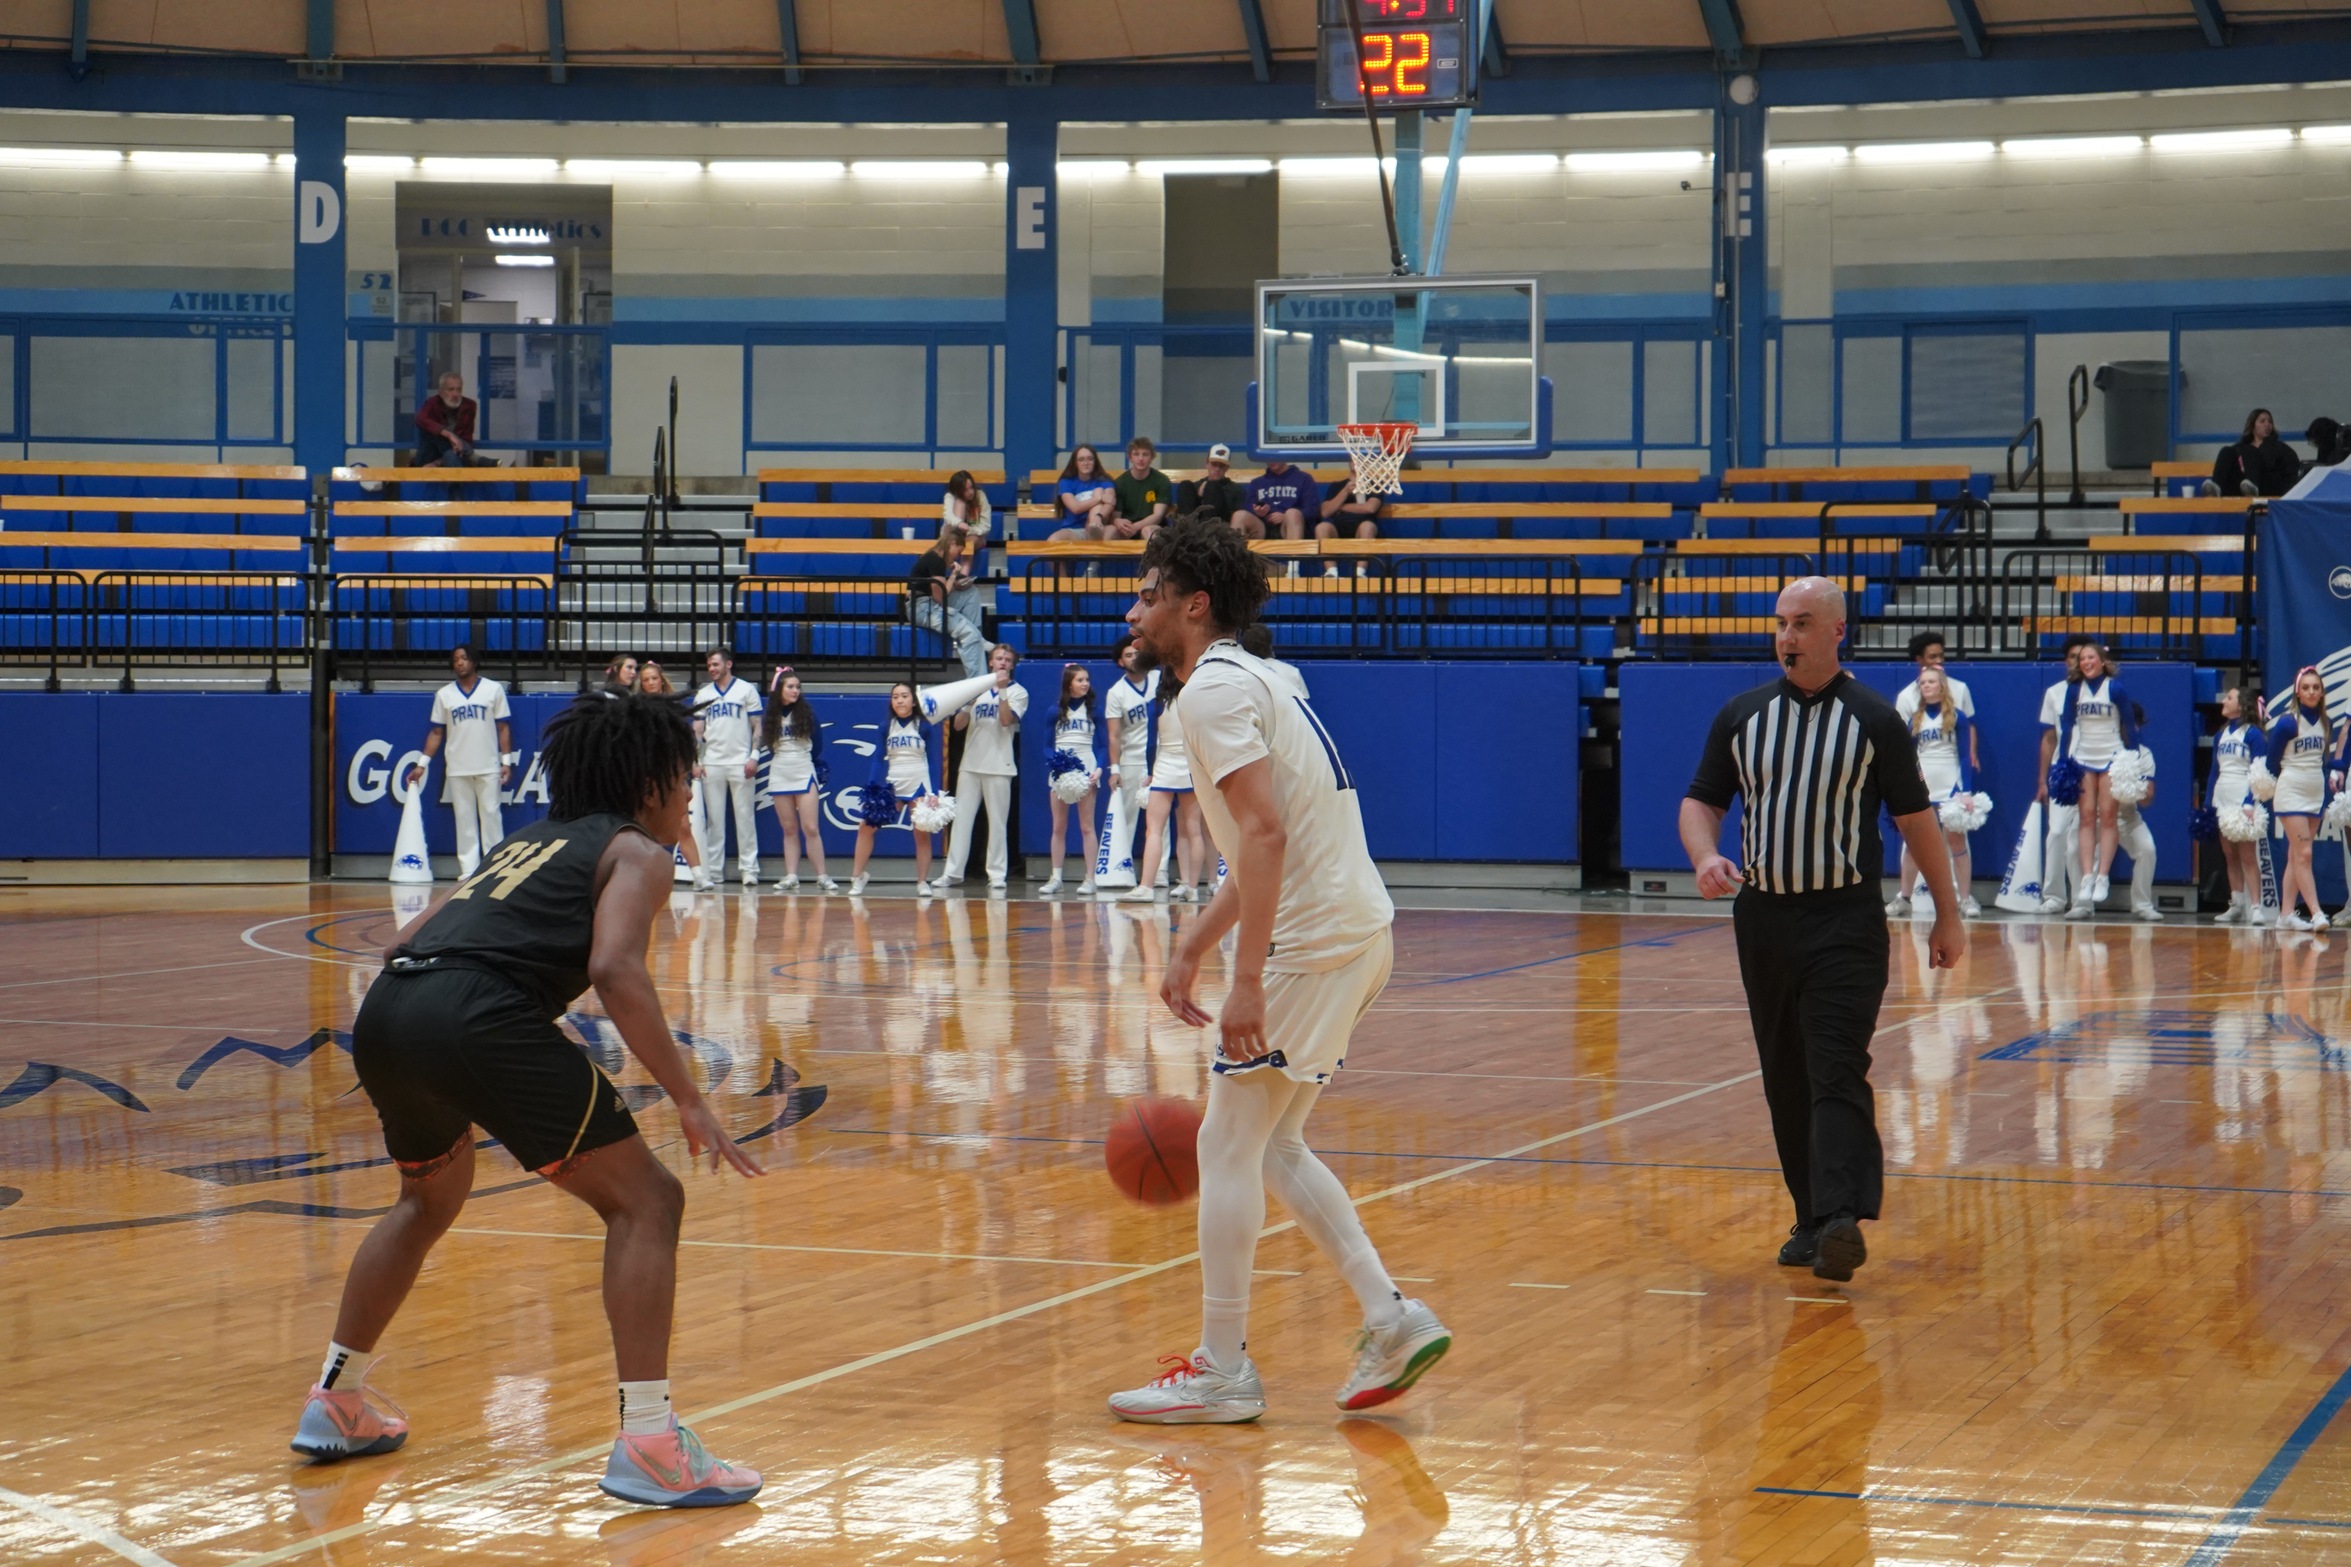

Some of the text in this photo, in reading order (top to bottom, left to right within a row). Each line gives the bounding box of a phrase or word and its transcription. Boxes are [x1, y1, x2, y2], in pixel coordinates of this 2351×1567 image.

[1360, 33, 1430, 95] 22
[300, 181, 340, 243] D
[1017, 187, 1045, 249] E
[1725, 172, 1752, 236] E
[169, 292, 293, 312] ATHLETIC
[1257, 485, 1298, 501] K-STATE
[451, 703, 488, 726] PRATT
[706, 702, 743, 722] PRATT
[975, 703, 1000, 723] PRAT
[887, 735, 922, 750] PRATT
[2294, 735, 2324, 755] PRAT
[1095, 813, 1114, 875] BEAVERS
[449, 838, 569, 901] 24
[2258, 838, 2278, 908] BEAVERS
